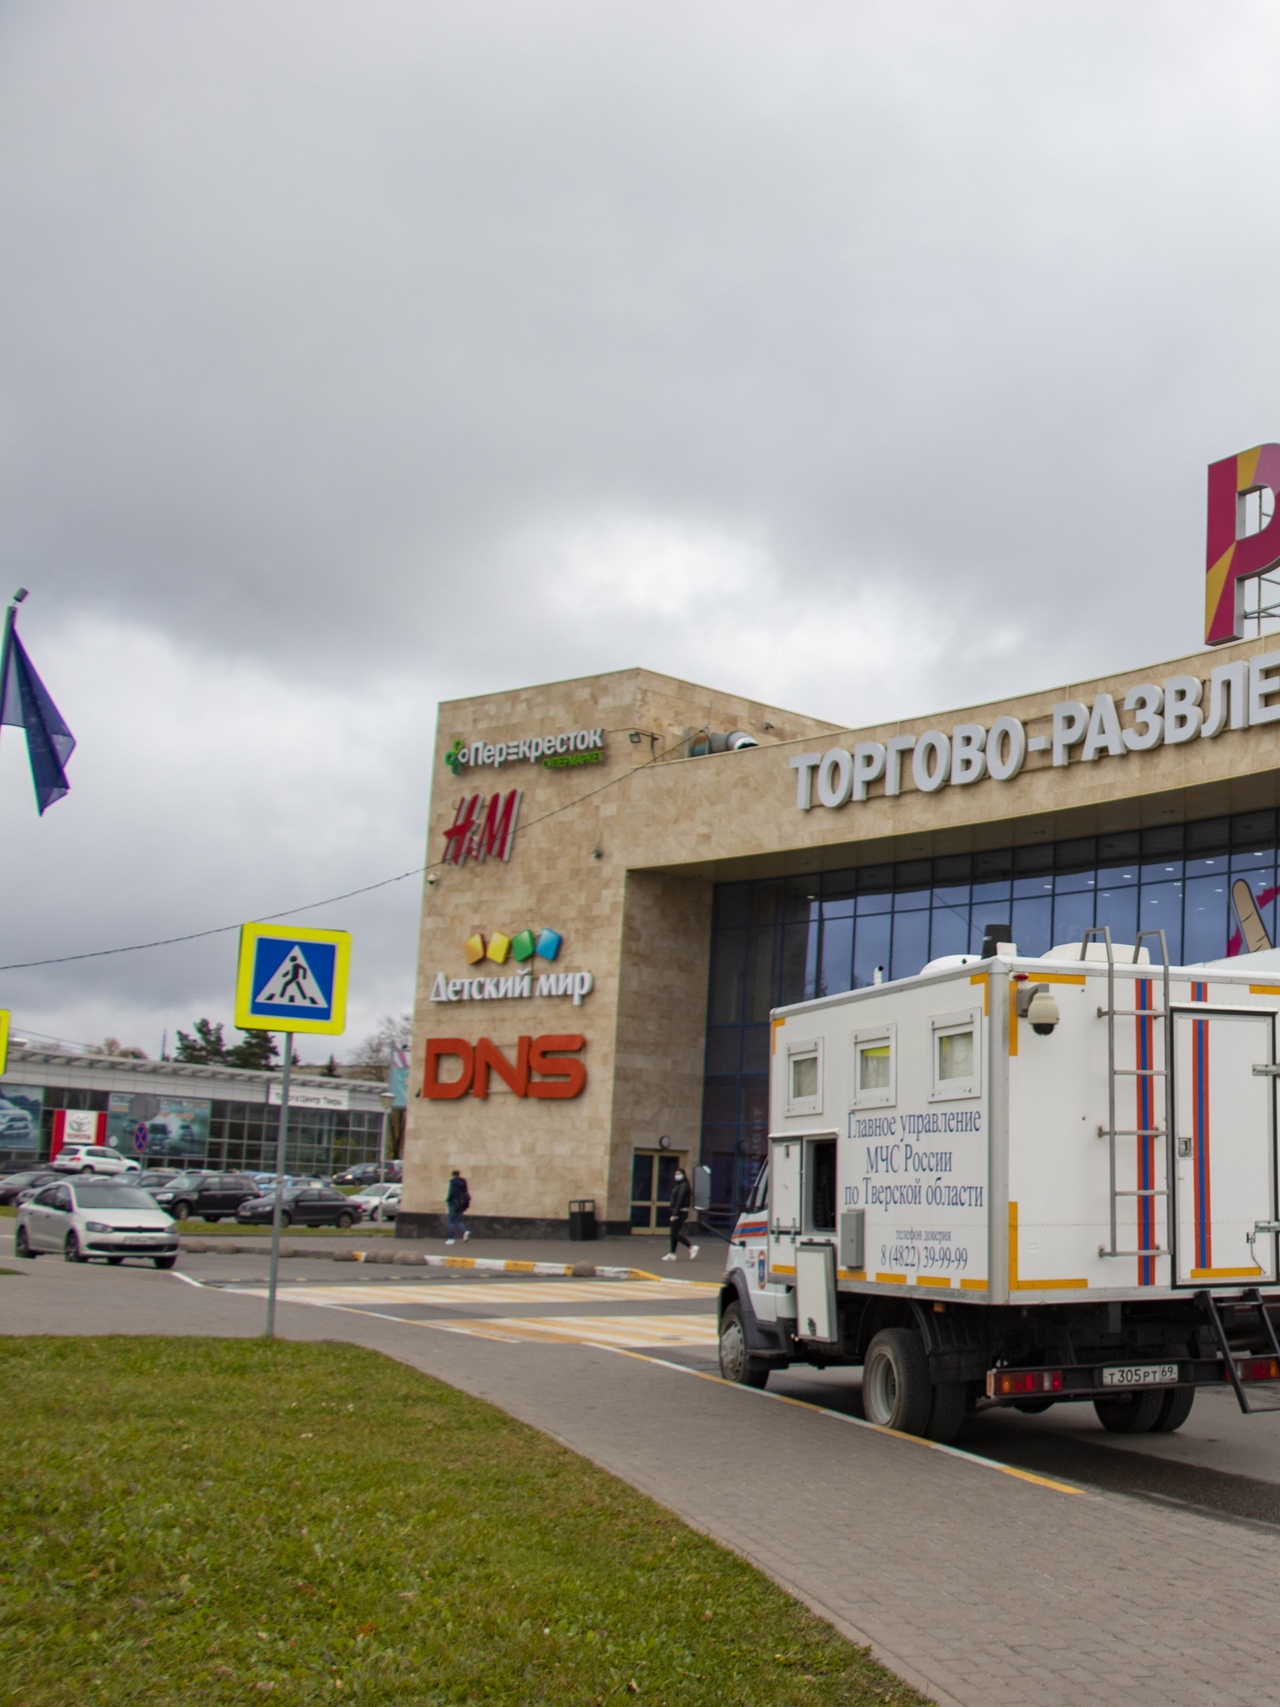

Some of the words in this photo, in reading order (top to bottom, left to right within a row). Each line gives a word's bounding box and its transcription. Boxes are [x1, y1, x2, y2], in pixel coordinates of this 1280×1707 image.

[469, 728, 605, 768] Перекресток
[442, 788, 523, 867] H&M
[428, 968, 532, 1002] Детский
[535, 970, 594, 1006] мир
[423, 1033, 587, 1099] DNS
[847, 1111, 896, 1139] Главное
[900, 1110, 981, 1143] управление
[866, 1144, 900, 1174] МЧС
[903, 1143, 952, 1173] России
[844, 1185, 859, 1205] по
[862, 1177, 922, 1212] Тверской
[925, 1176, 983, 1208] области
[895, 1226, 922, 1244] телефон
[923, 1229, 952, 1244] доверия
[880, 1244, 887, 1266] 8
[888, 1244, 921, 1272] (4822)
[923, 1246, 968, 1270] 39-99-99
